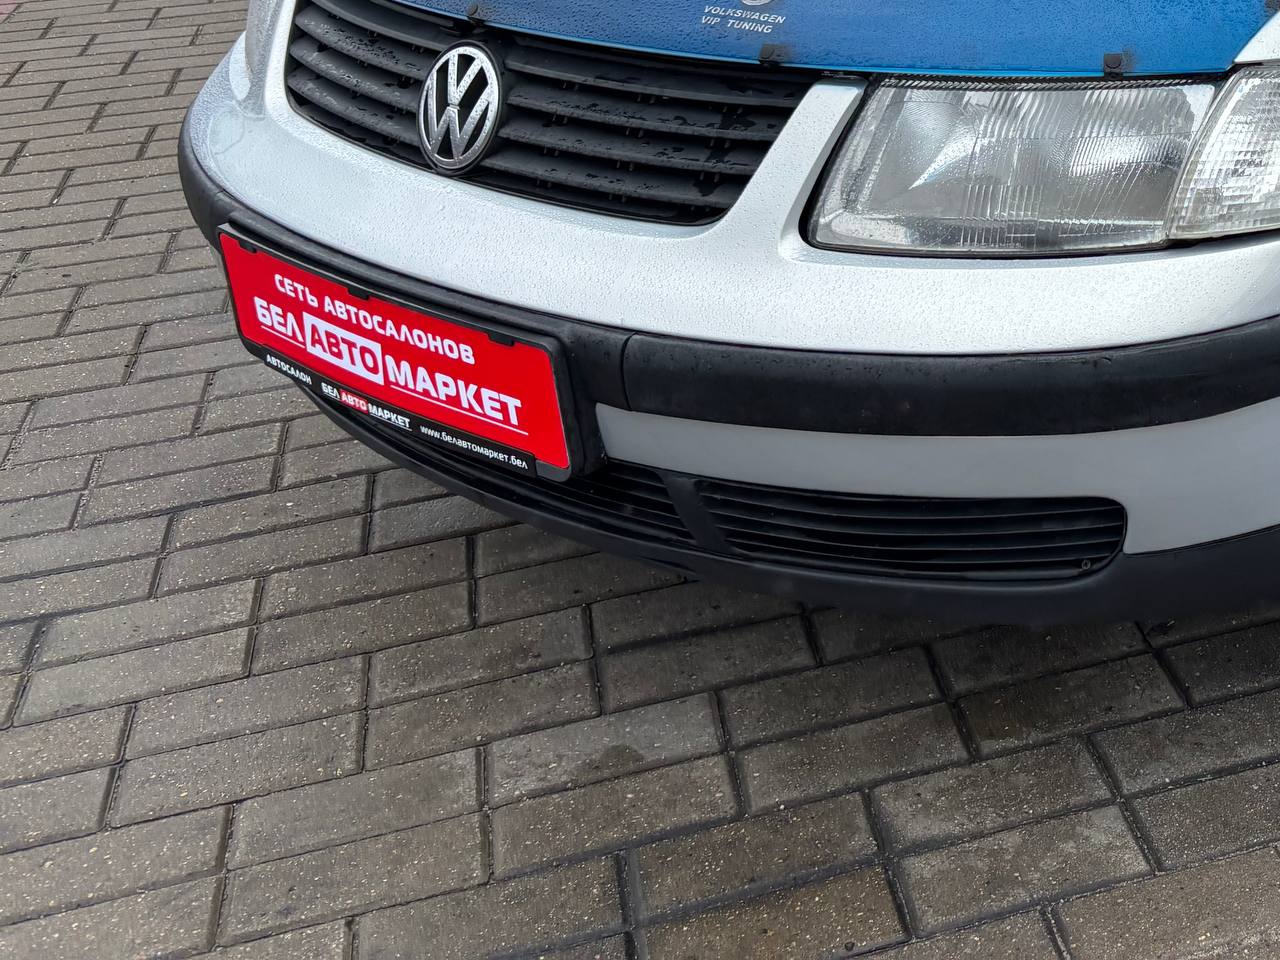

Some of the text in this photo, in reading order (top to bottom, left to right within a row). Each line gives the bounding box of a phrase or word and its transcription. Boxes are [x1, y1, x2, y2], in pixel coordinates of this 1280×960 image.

[701, 15, 773, 33] VIP TUNING
[703, 5, 786, 24] VOLKSWAGEN
[274, 272, 476, 365] СЕТЬ АВТОСАЛОНОВ
[265, 353, 312, 386] АВТОСАЛОН
[419, 424, 528, 470] www.белавтомаркет.бел
